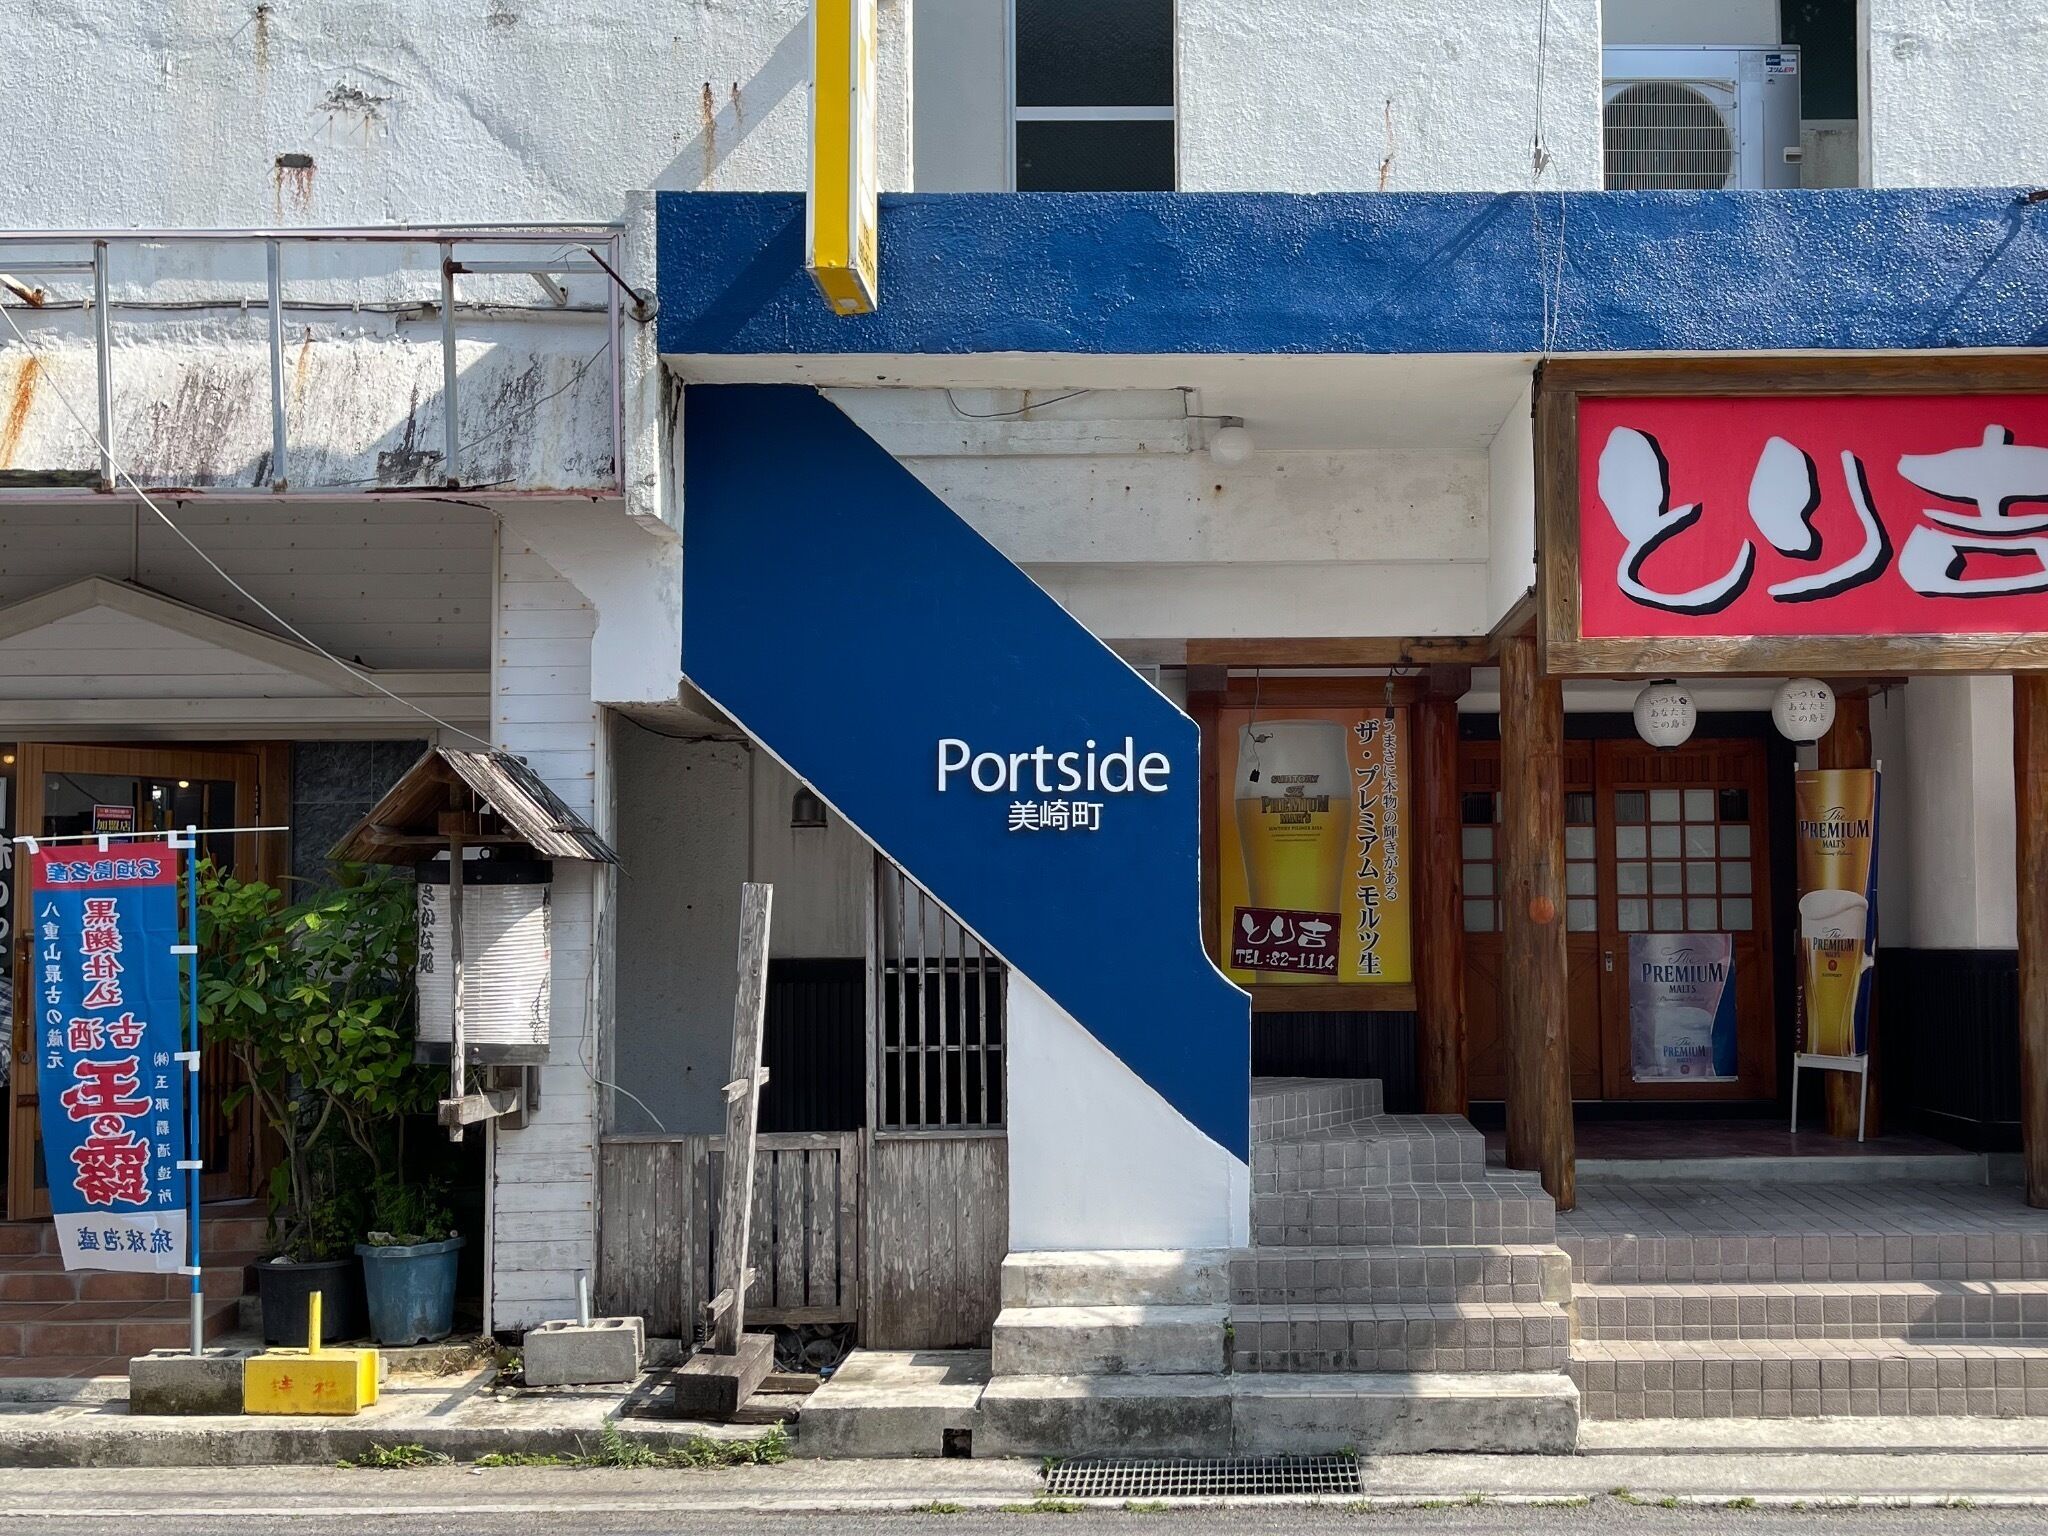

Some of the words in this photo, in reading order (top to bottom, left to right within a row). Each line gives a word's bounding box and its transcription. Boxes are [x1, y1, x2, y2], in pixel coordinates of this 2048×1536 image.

[1597, 423, 2048, 615] とり吉
[937, 736, 1171, 793] Portside
[1008, 799, 1104, 831] 美崎町
[1800, 819, 1869, 838] PREMIUM
[1241, 913, 1332, 948] とり吉
[1812, 936, 1855, 952] PREMIUM
[1642, 962, 1724, 983] PREMIUM
[1663, 1044, 1706, 1057] PREMIUM
